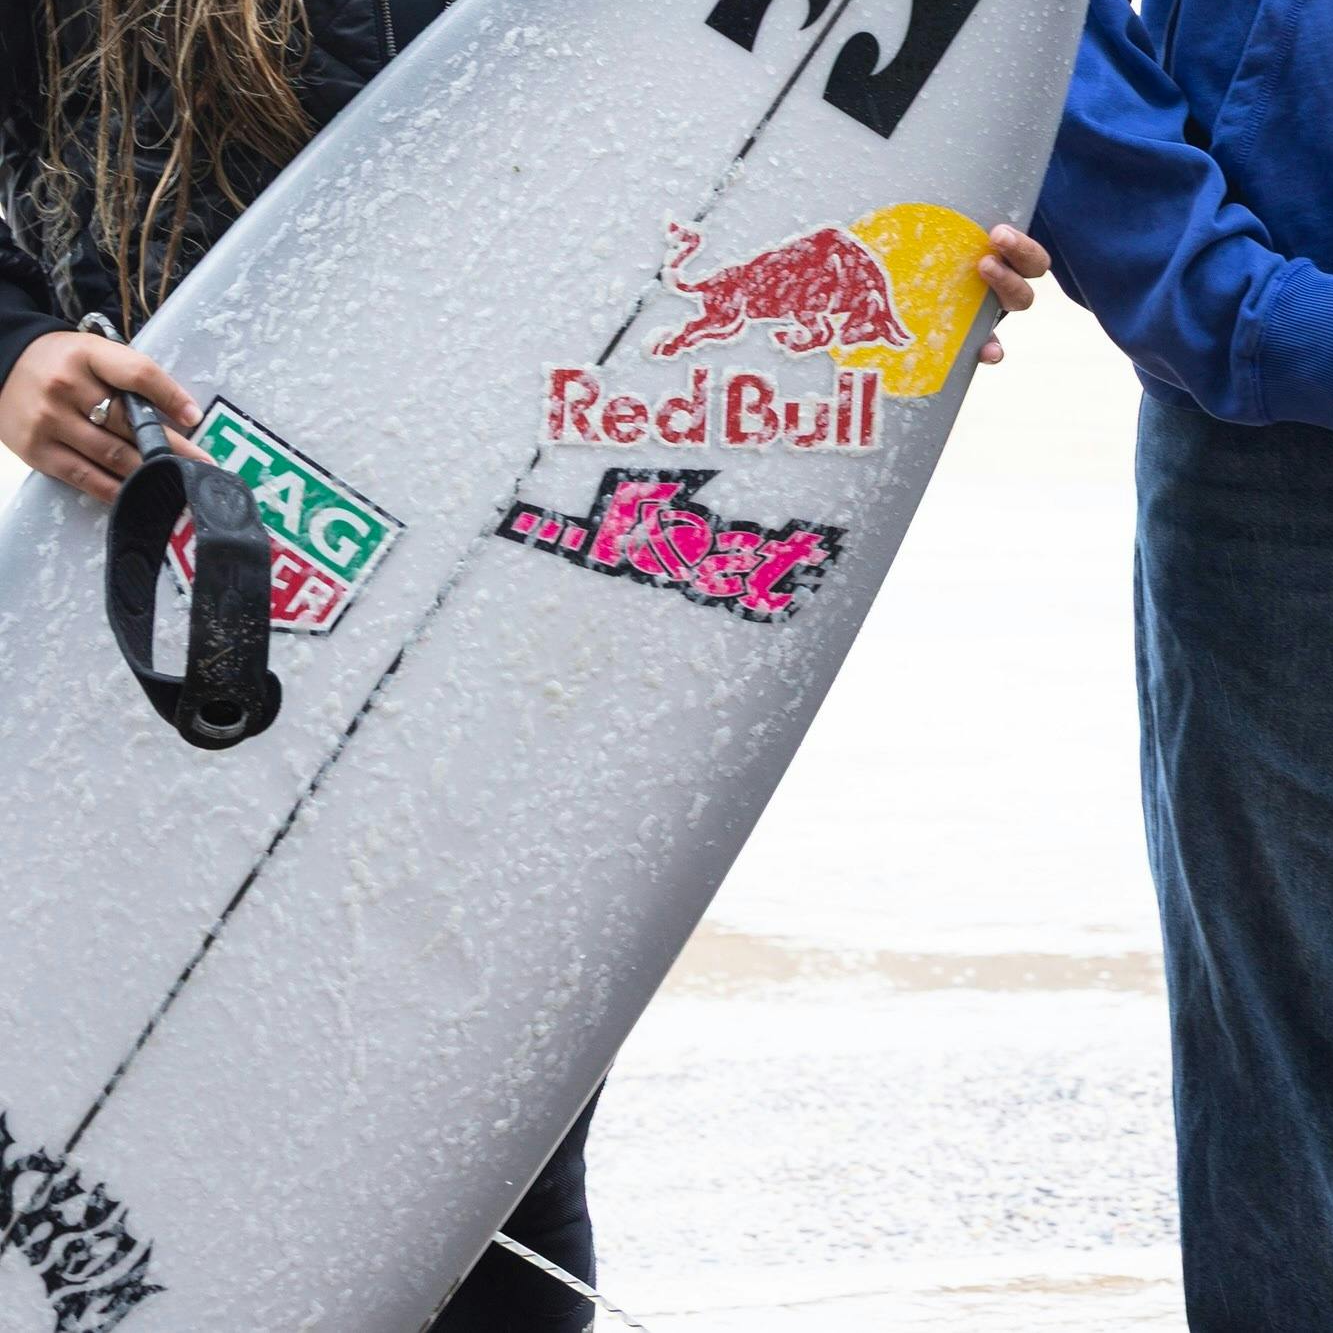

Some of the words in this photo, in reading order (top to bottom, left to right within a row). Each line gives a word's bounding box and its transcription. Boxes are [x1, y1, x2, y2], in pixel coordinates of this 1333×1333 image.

[548, 367, 708, 443] Red
[725, 372, 879, 448] Bull
[219, 425, 372, 569] TAG
